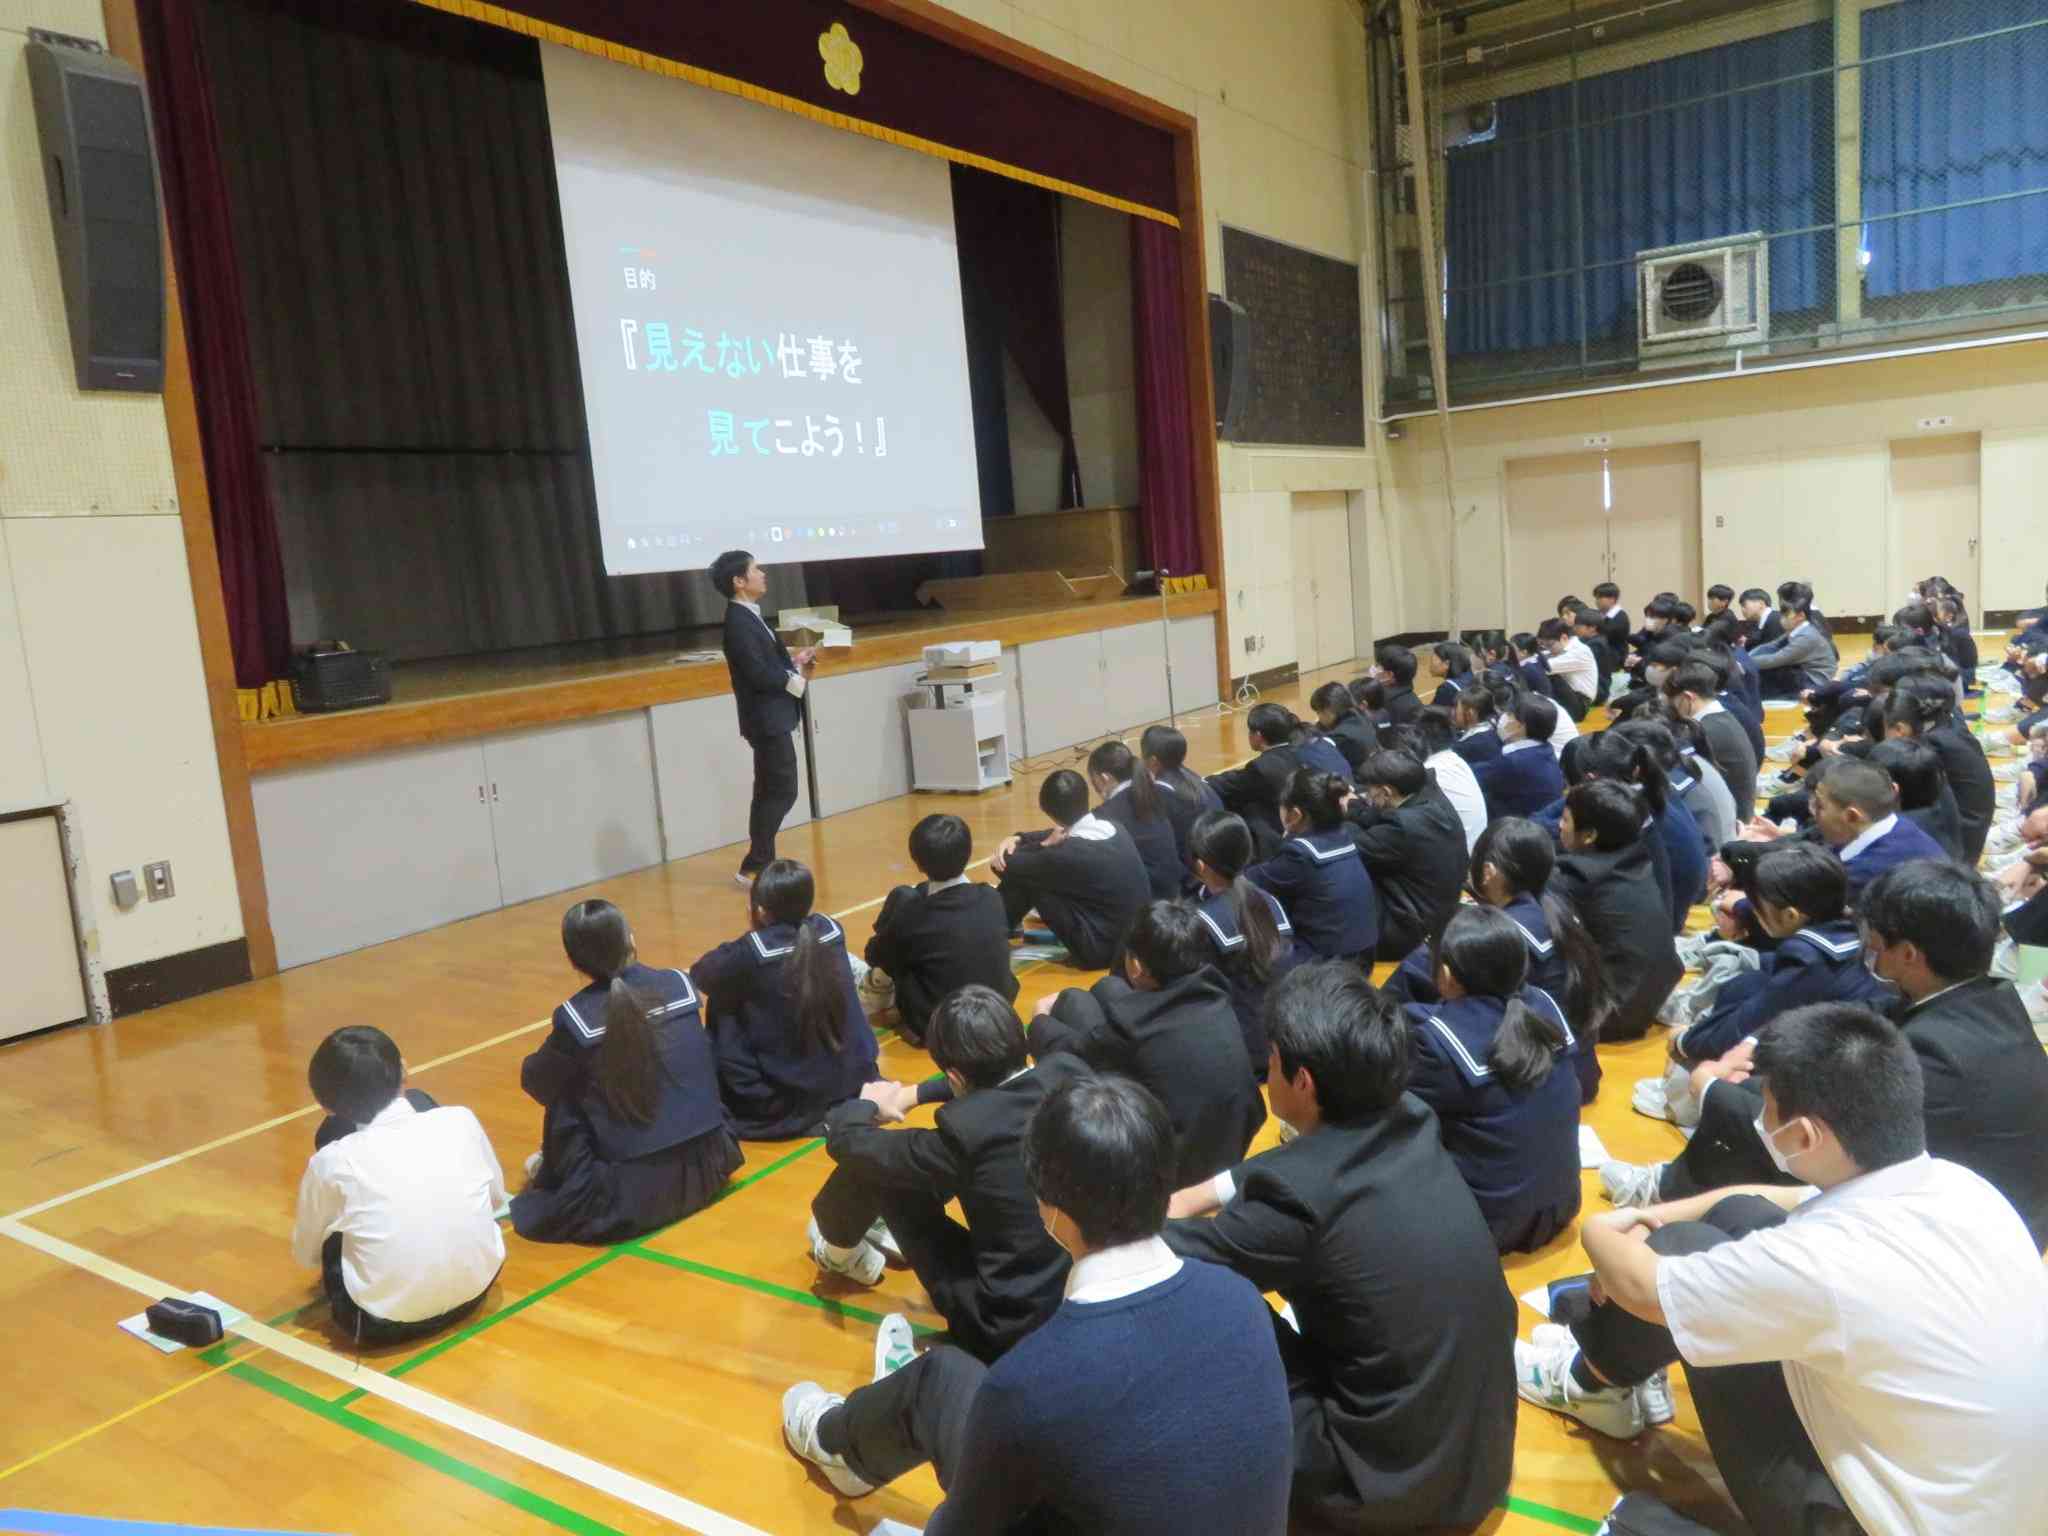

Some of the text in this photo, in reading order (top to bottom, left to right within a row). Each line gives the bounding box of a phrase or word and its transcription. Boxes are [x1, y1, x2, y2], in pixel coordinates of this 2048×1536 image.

[624, 267, 656, 290] 目的
[620, 318, 862, 384] 『見えない仕事を
